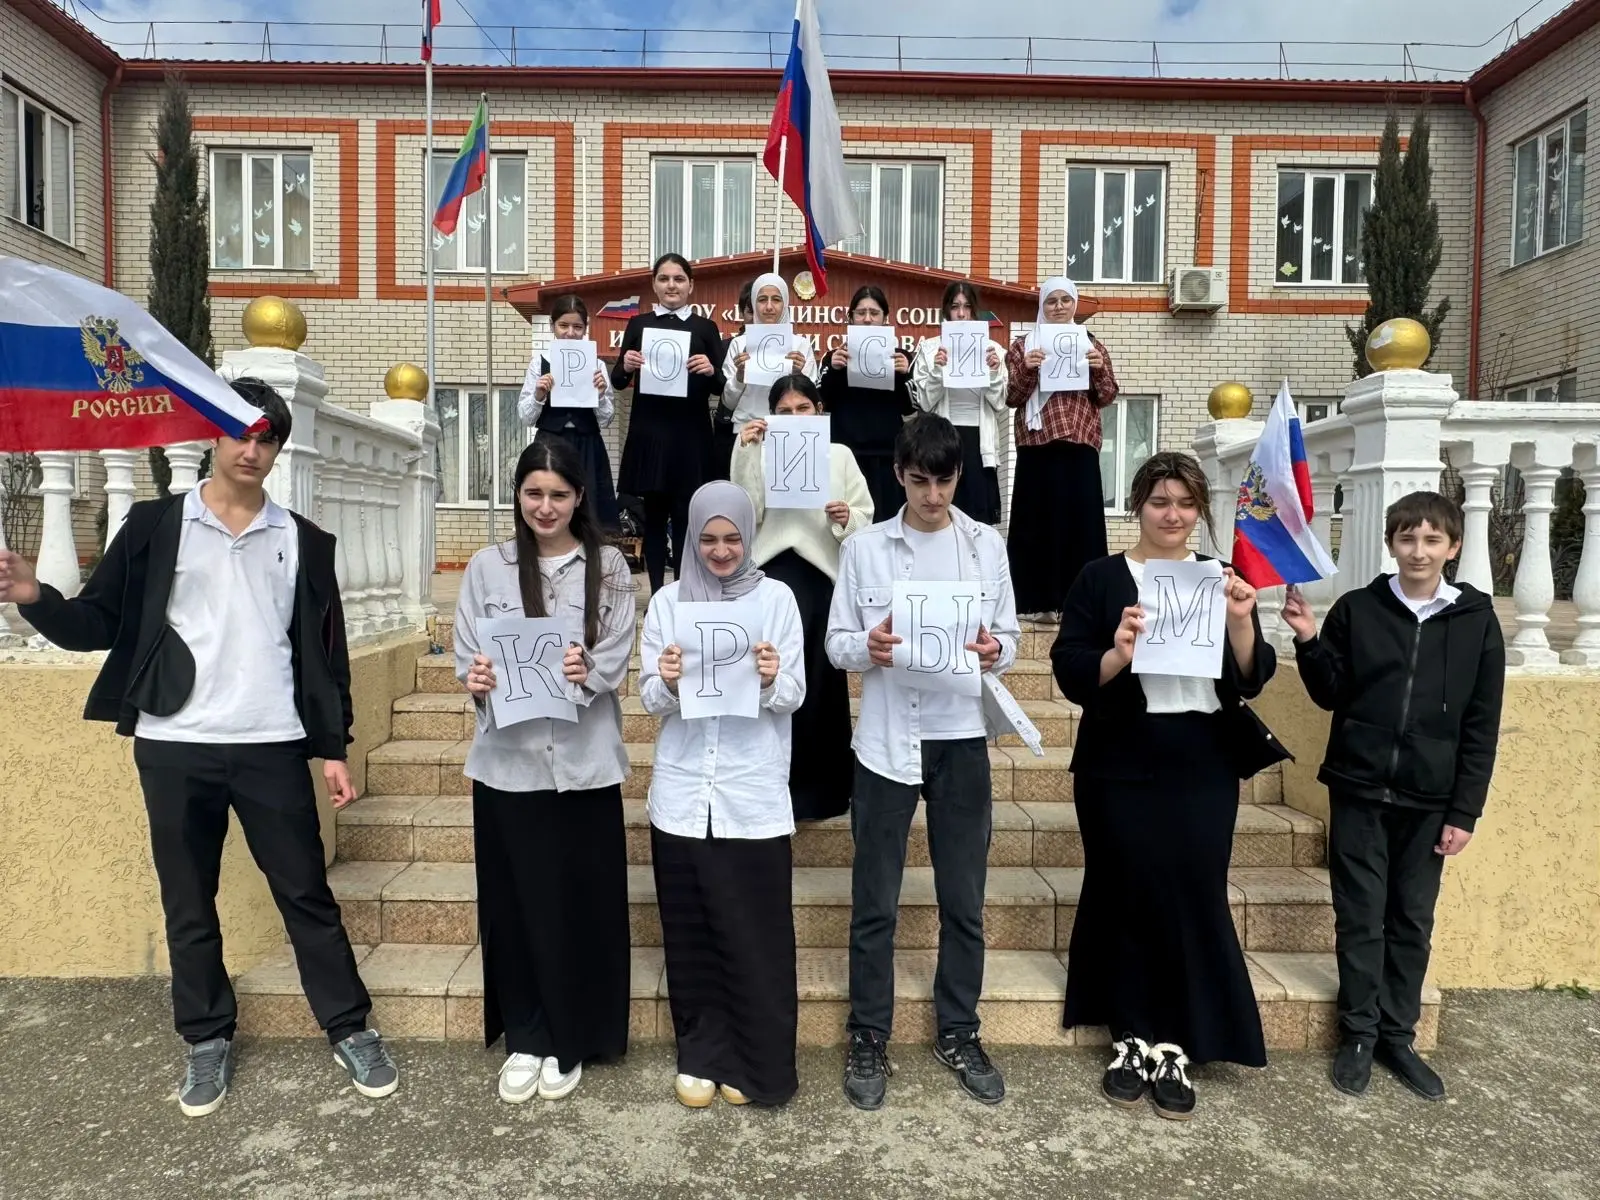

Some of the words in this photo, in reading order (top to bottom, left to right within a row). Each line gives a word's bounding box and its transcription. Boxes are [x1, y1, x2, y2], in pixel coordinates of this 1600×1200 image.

[559, 348, 587, 388] Р
[649, 338, 683, 382] О
[756, 333, 785, 373] С
[857, 335, 887, 379] С
[949, 332, 985, 377] И
[1048, 332, 1080, 379] Я
[72, 395, 175, 418] РОССИЯ
[770, 431, 821, 492] И
[906, 594, 974, 675] Ы
[1146, 575, 1222, 648] М
[492, 632, 568, 702] К
[694, 621, 750, 698] Р
